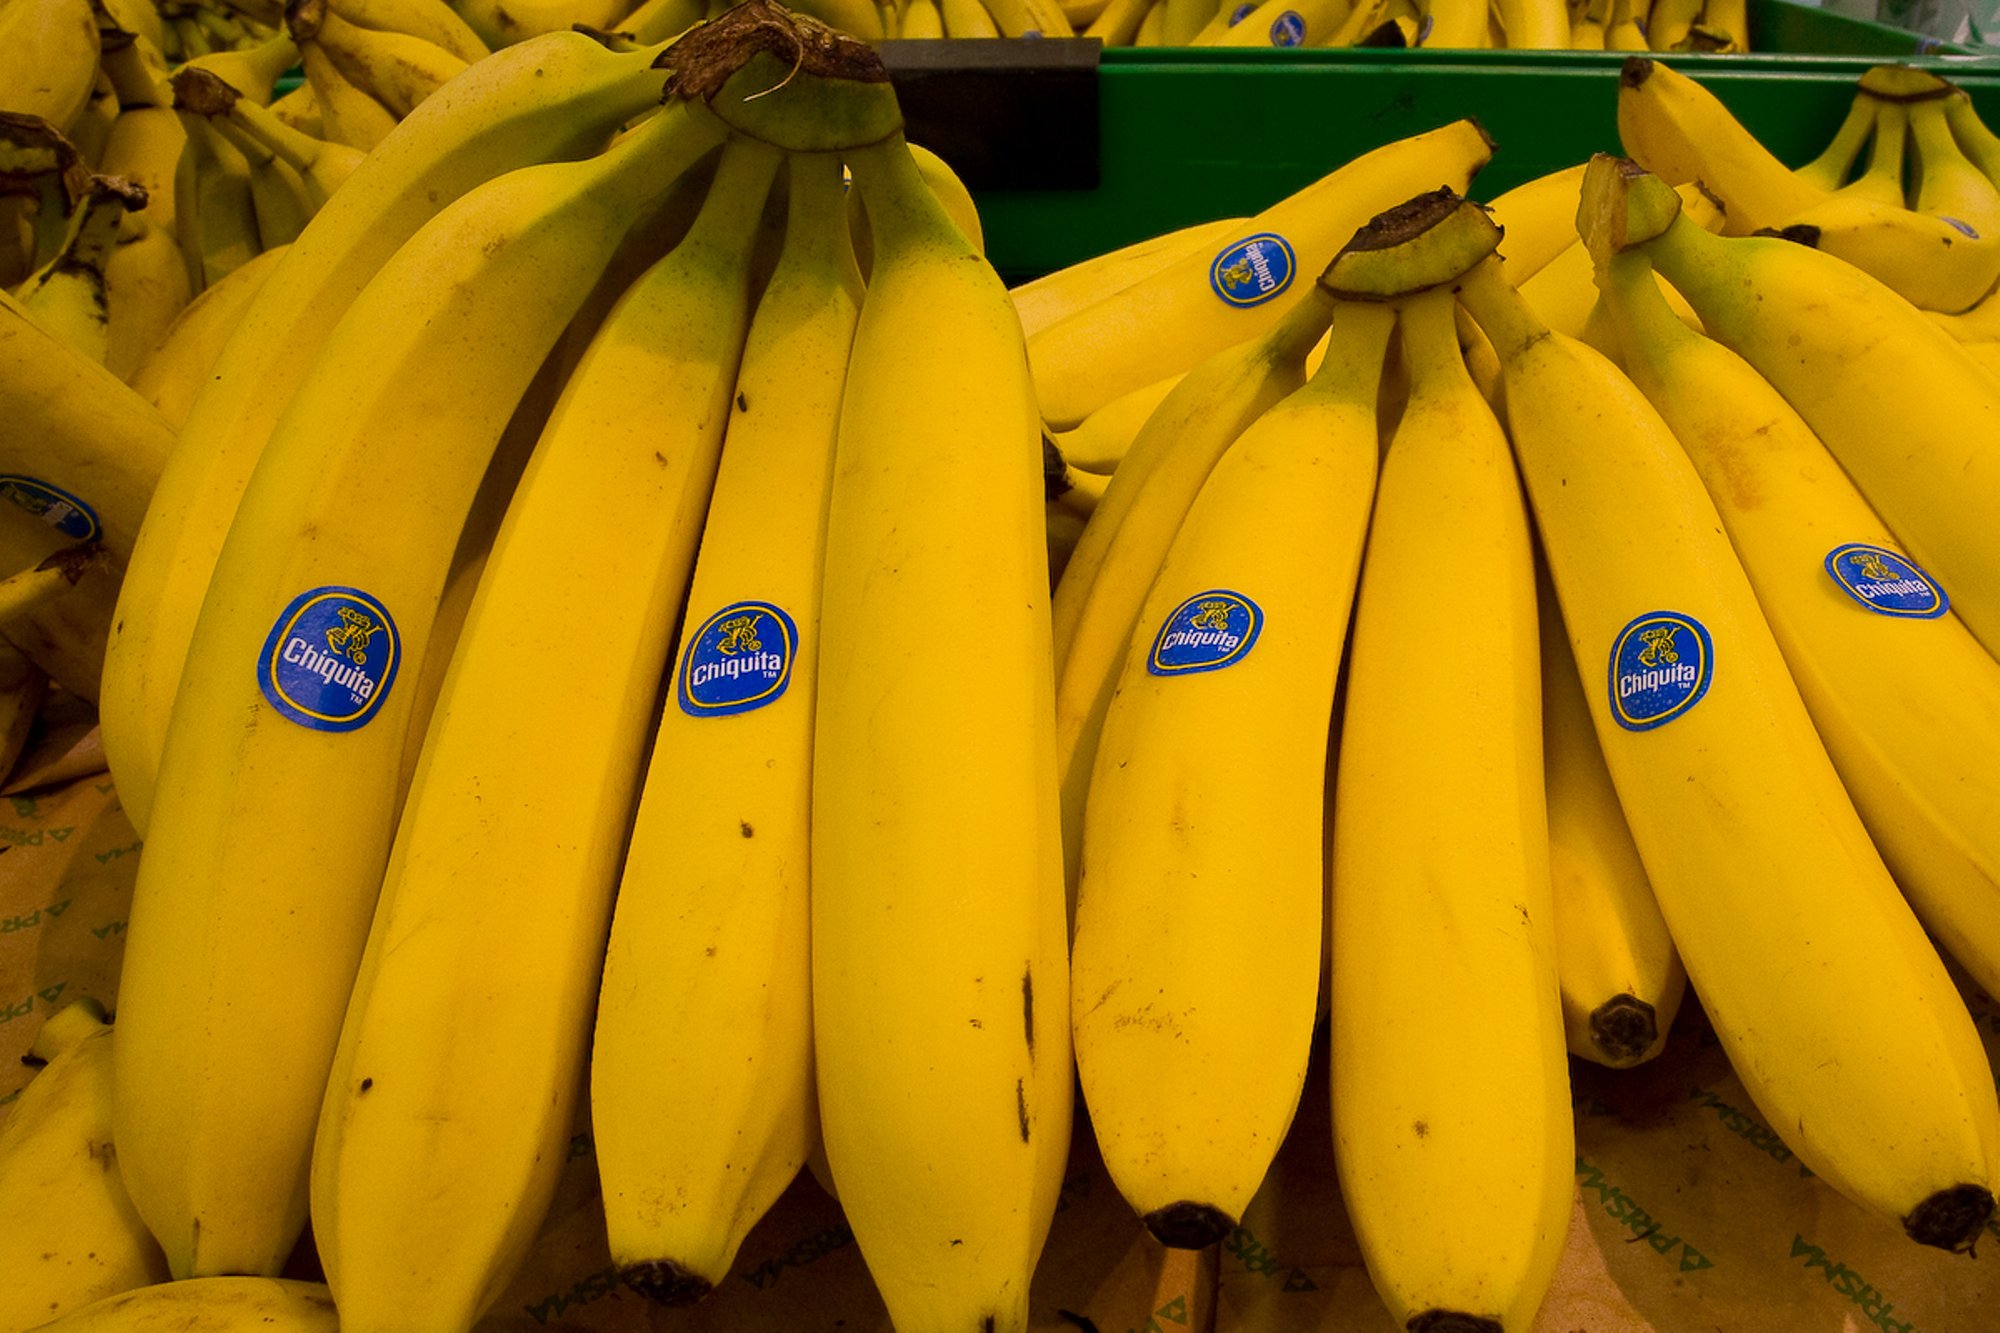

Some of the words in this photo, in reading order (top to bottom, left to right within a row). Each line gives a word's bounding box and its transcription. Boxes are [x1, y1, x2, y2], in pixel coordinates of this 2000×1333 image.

[1245, 242, 1276, 292] Chiquita
[1855, 579, 1929, 599] Chiquita
[1162, 628, 1240, 650] Chiquita
[282, 637, 375, 699] Chiquita
[692, 651, 782, 686] Chiquita
[1620, 662, 1696, 698] Chiquita
[350, 692, 364, 705] TM
